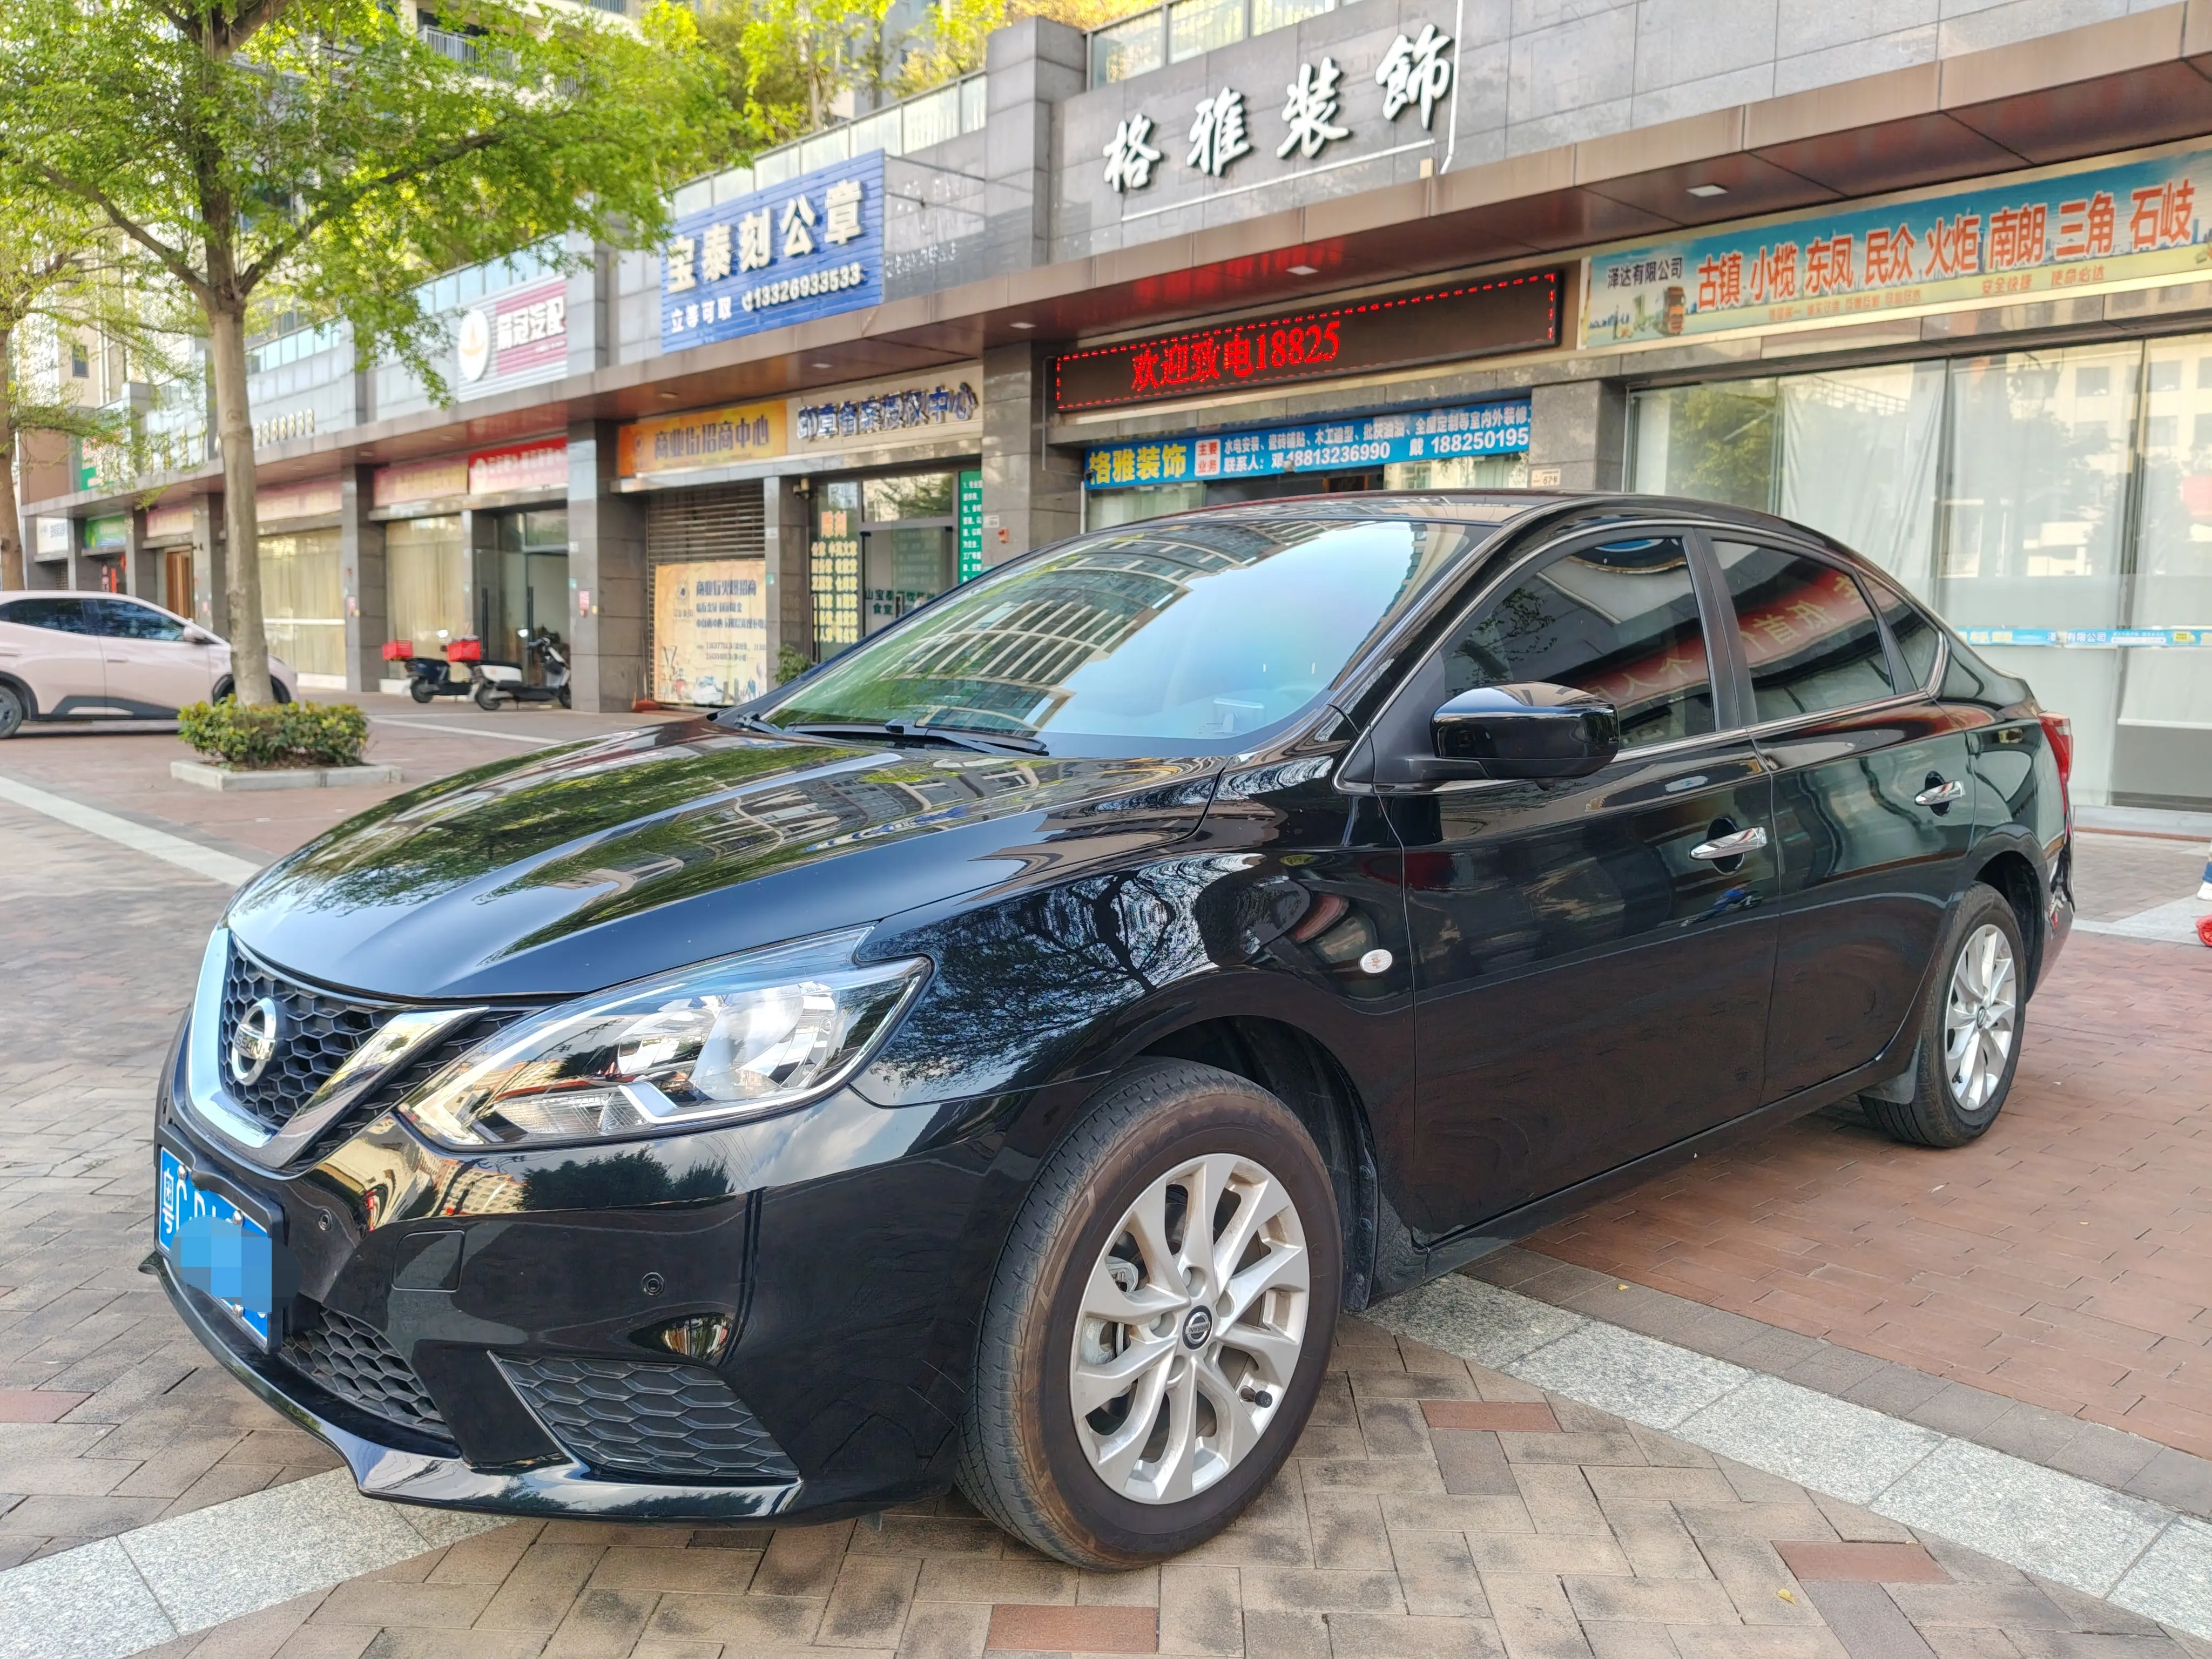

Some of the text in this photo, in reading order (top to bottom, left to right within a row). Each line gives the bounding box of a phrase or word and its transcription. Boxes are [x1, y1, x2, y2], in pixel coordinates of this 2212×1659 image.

[667, 179, 862, 293] 宝泰刻公章
[1698, 178, 2195, 309] 古镇 小榄 东凤 民众 火炬 南朗 三角 石岐
[1608, 257, 1683, 289] 泽达有限公司
[671, 261, 862, 333] 立等可取 13326933533
[1131, 321, 1340, 392] 欢迎致电18825
[1088, 443, 1187, 486] 格雅装饰
[1197, 441, 1218, 456] 主要
[1197, 458, 1218, 474] 业务
[1286, 441, 1391, 467] 18813236990
[1431, 427, 1529, 454] 188250195
